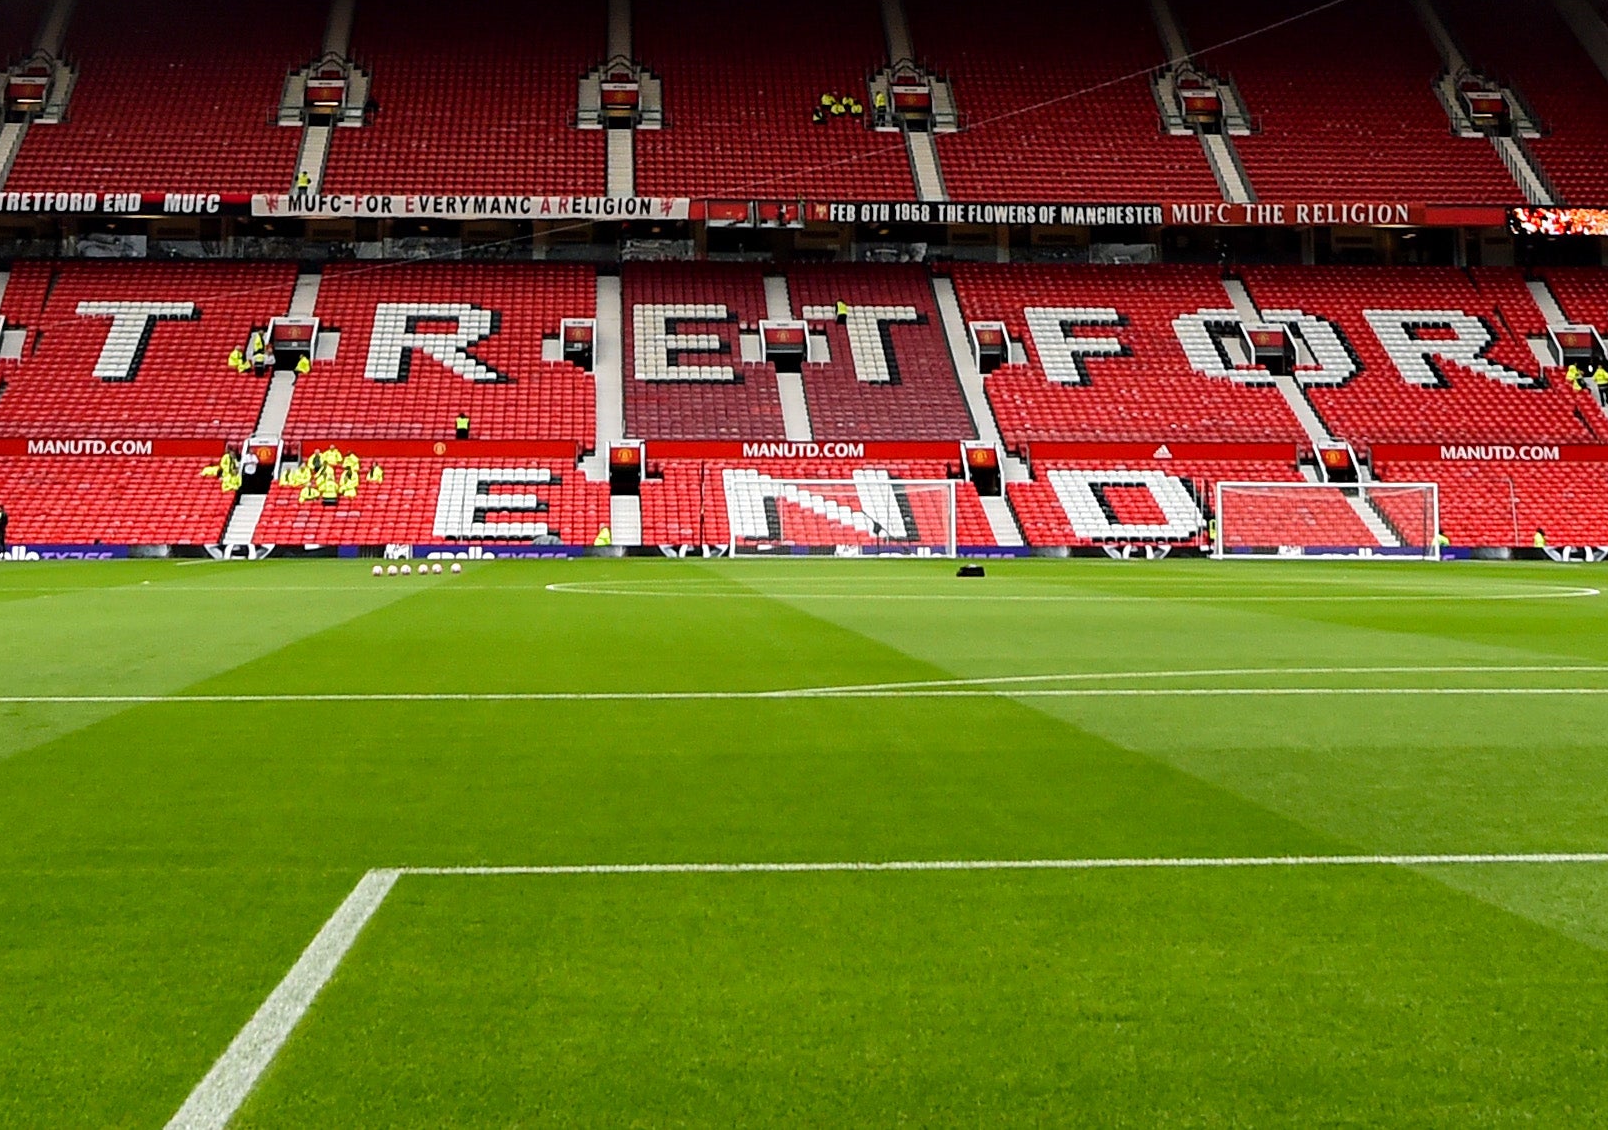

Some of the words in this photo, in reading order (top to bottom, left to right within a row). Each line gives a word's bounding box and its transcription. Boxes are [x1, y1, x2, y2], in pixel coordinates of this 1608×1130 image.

[103, 193, 141, 213] END
[163, 193, 221, 214] MUFC
[287, 196, 393, 214] MUFC-FOR
[404, 198, 532, 215] EVERYMANC
[539, 199, 552, 215] A
[557, 198, 652, 216] RELIGION
[829, 203, 856, 222] FEB
[860, 204, 890, 222] 6TH
[937, 204, 965, 223] THE
[967, 204, 1036, 224] FLOWERS
[1038, 205, 1057, 224] OF
[1060, 205, 1163, 225] MANCHESTER
[1171, 206, 1231, 224] MUFC
[1241, 204, 1285, 224] THE
[1295, 203, 1409, 225] RELIGION
[27, 438, 153, 457] MANUTD.COM
[742, 441, 865, 459] MANUTD.COM
[1440, 445, 1560, 462] MANUTD.COM
[433, 468, 1212, 542] END
